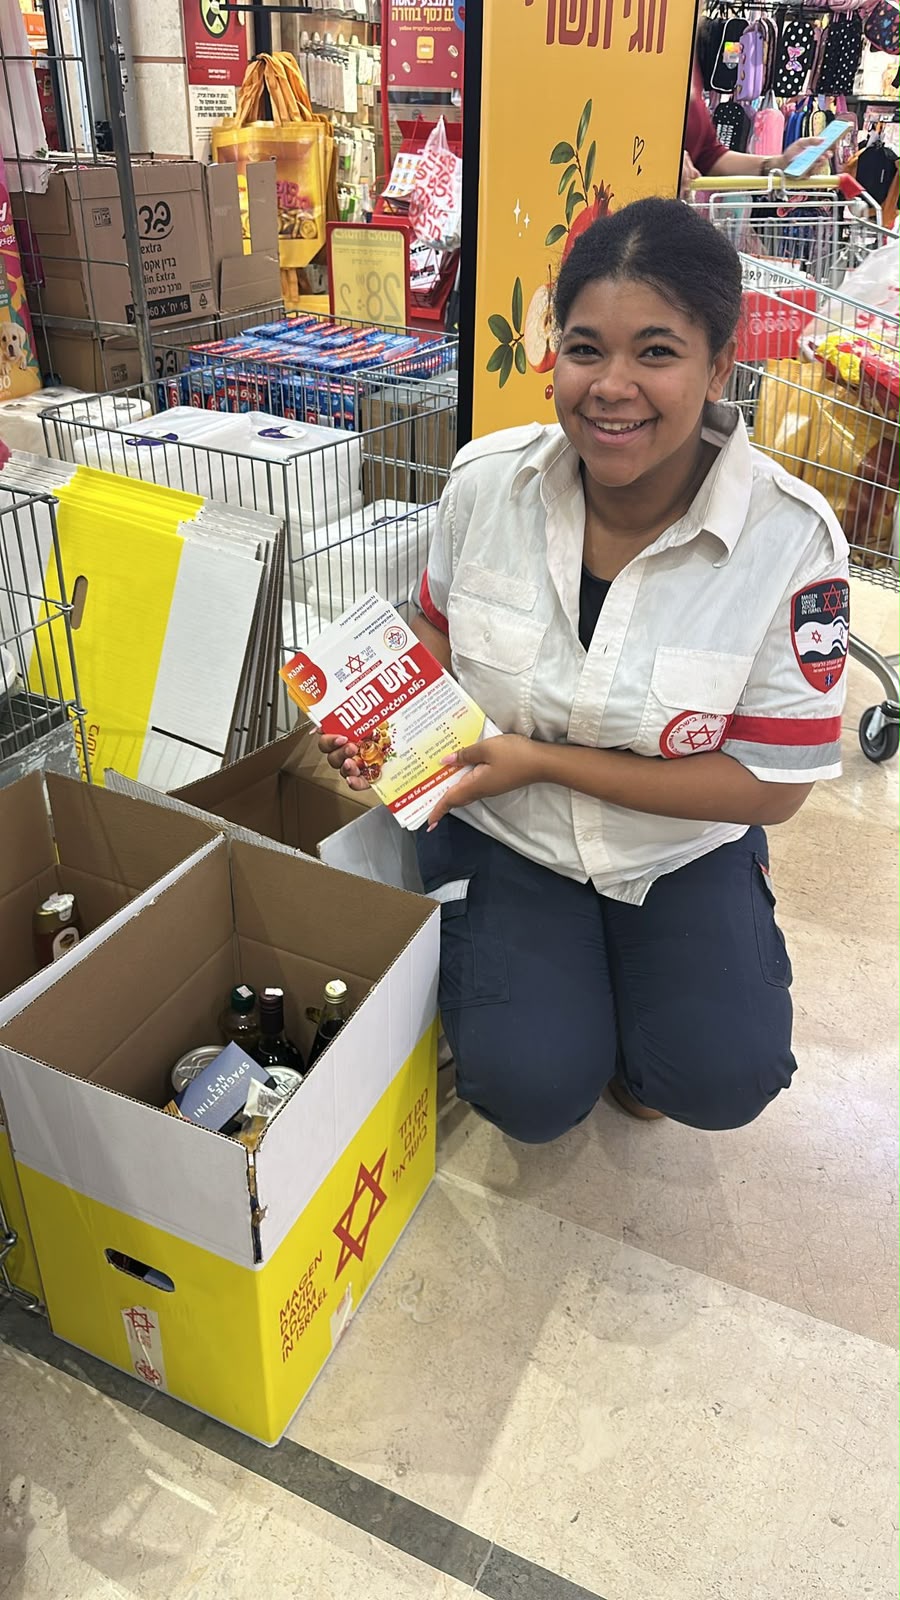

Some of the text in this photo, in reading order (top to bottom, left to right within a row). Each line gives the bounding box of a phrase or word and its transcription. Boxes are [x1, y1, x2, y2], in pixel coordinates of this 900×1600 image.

[391, 7, 421, 21] בחזרה
[144, 259, 160, 273] אקס
[376, 653, 420, 694] ראש
[406, 676, 425, 694] כולם
[333, 682, 383, 728] השנה
[380, 693, 407, 716] חוגגים
[193, 1061, 250, 1119] SPAGHETTINI
[279, 1249, 323, 1322] MAGEN
[280, 1280, 314, 1337] DAVID
[282, 1288, 318, 1350] ADOM
[282, 1287, 328, 1363] IN ISRAEL
